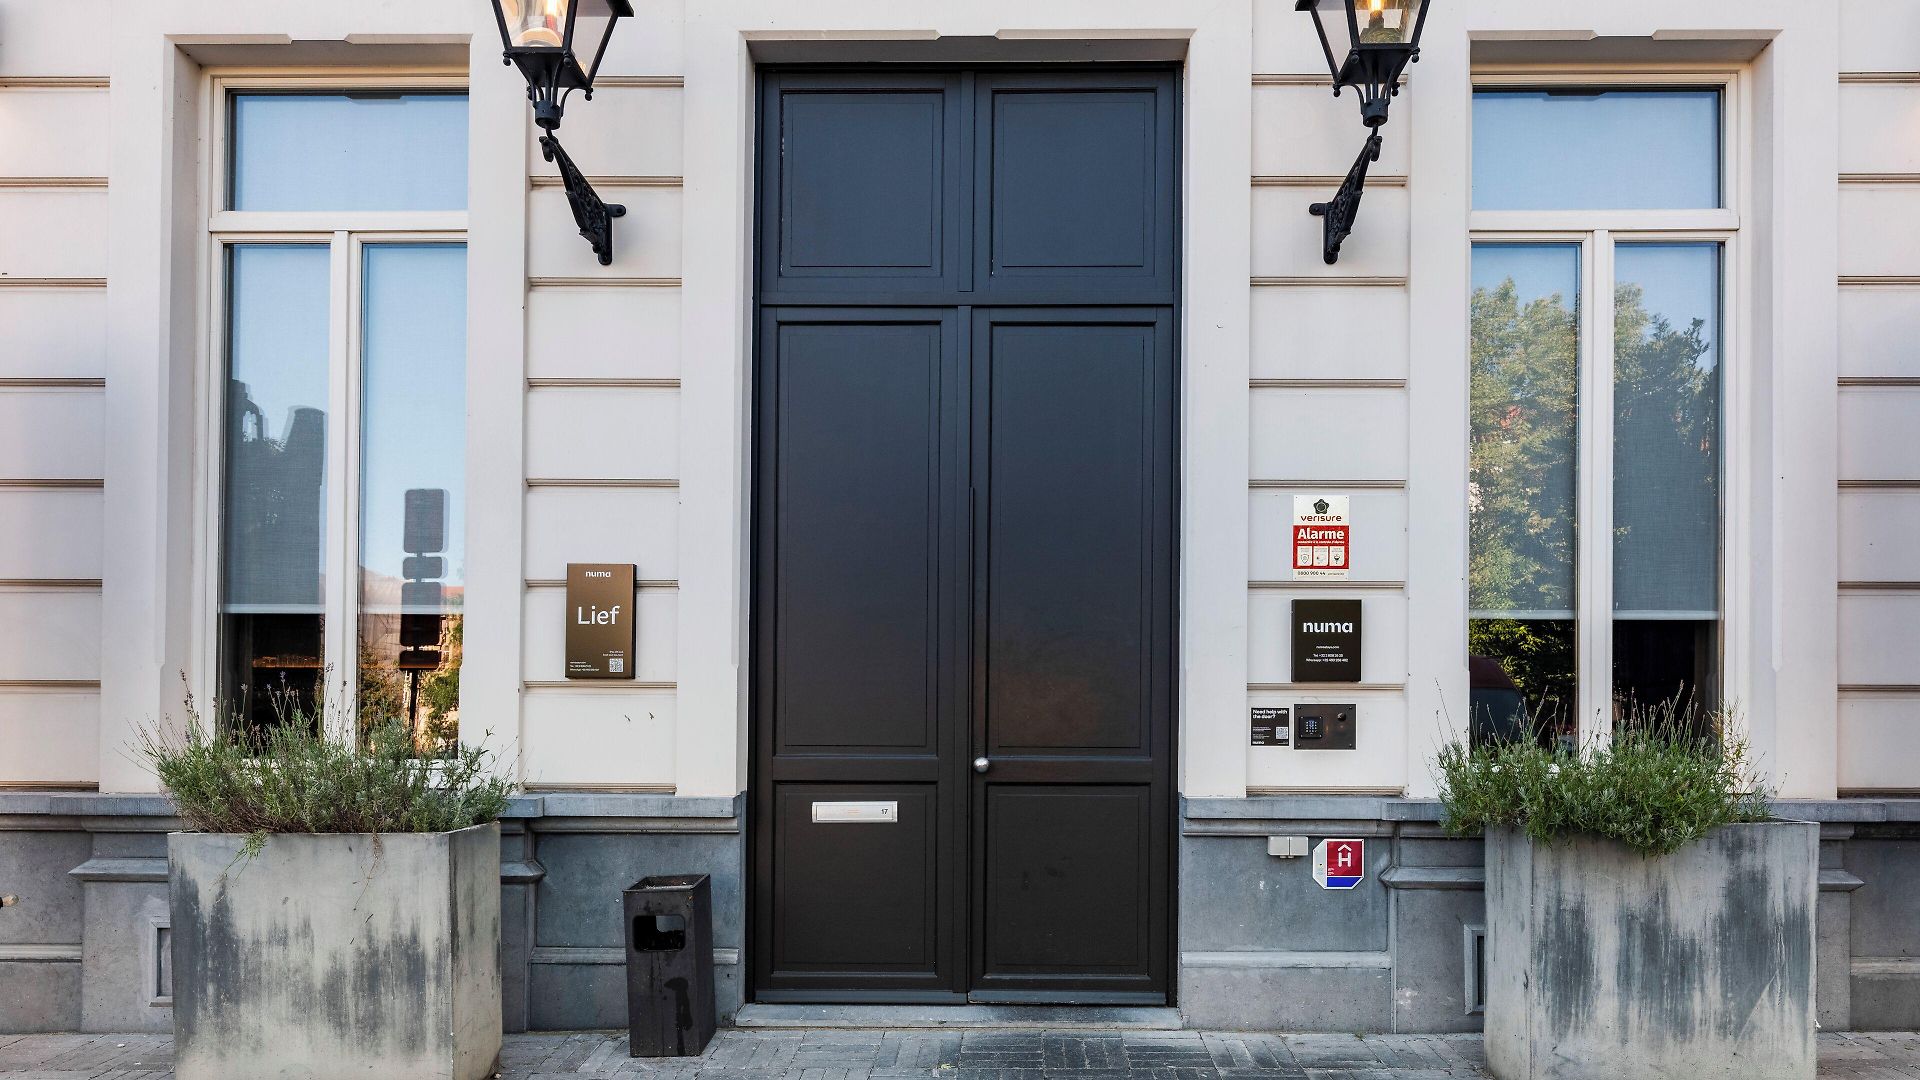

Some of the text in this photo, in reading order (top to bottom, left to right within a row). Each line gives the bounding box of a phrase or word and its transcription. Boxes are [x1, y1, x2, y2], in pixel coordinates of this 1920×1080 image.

[1298, 528, 1344, 539] Alarme
[578, 606, 620, 624] Lief
[1303, 622, 1352, 633] numa
